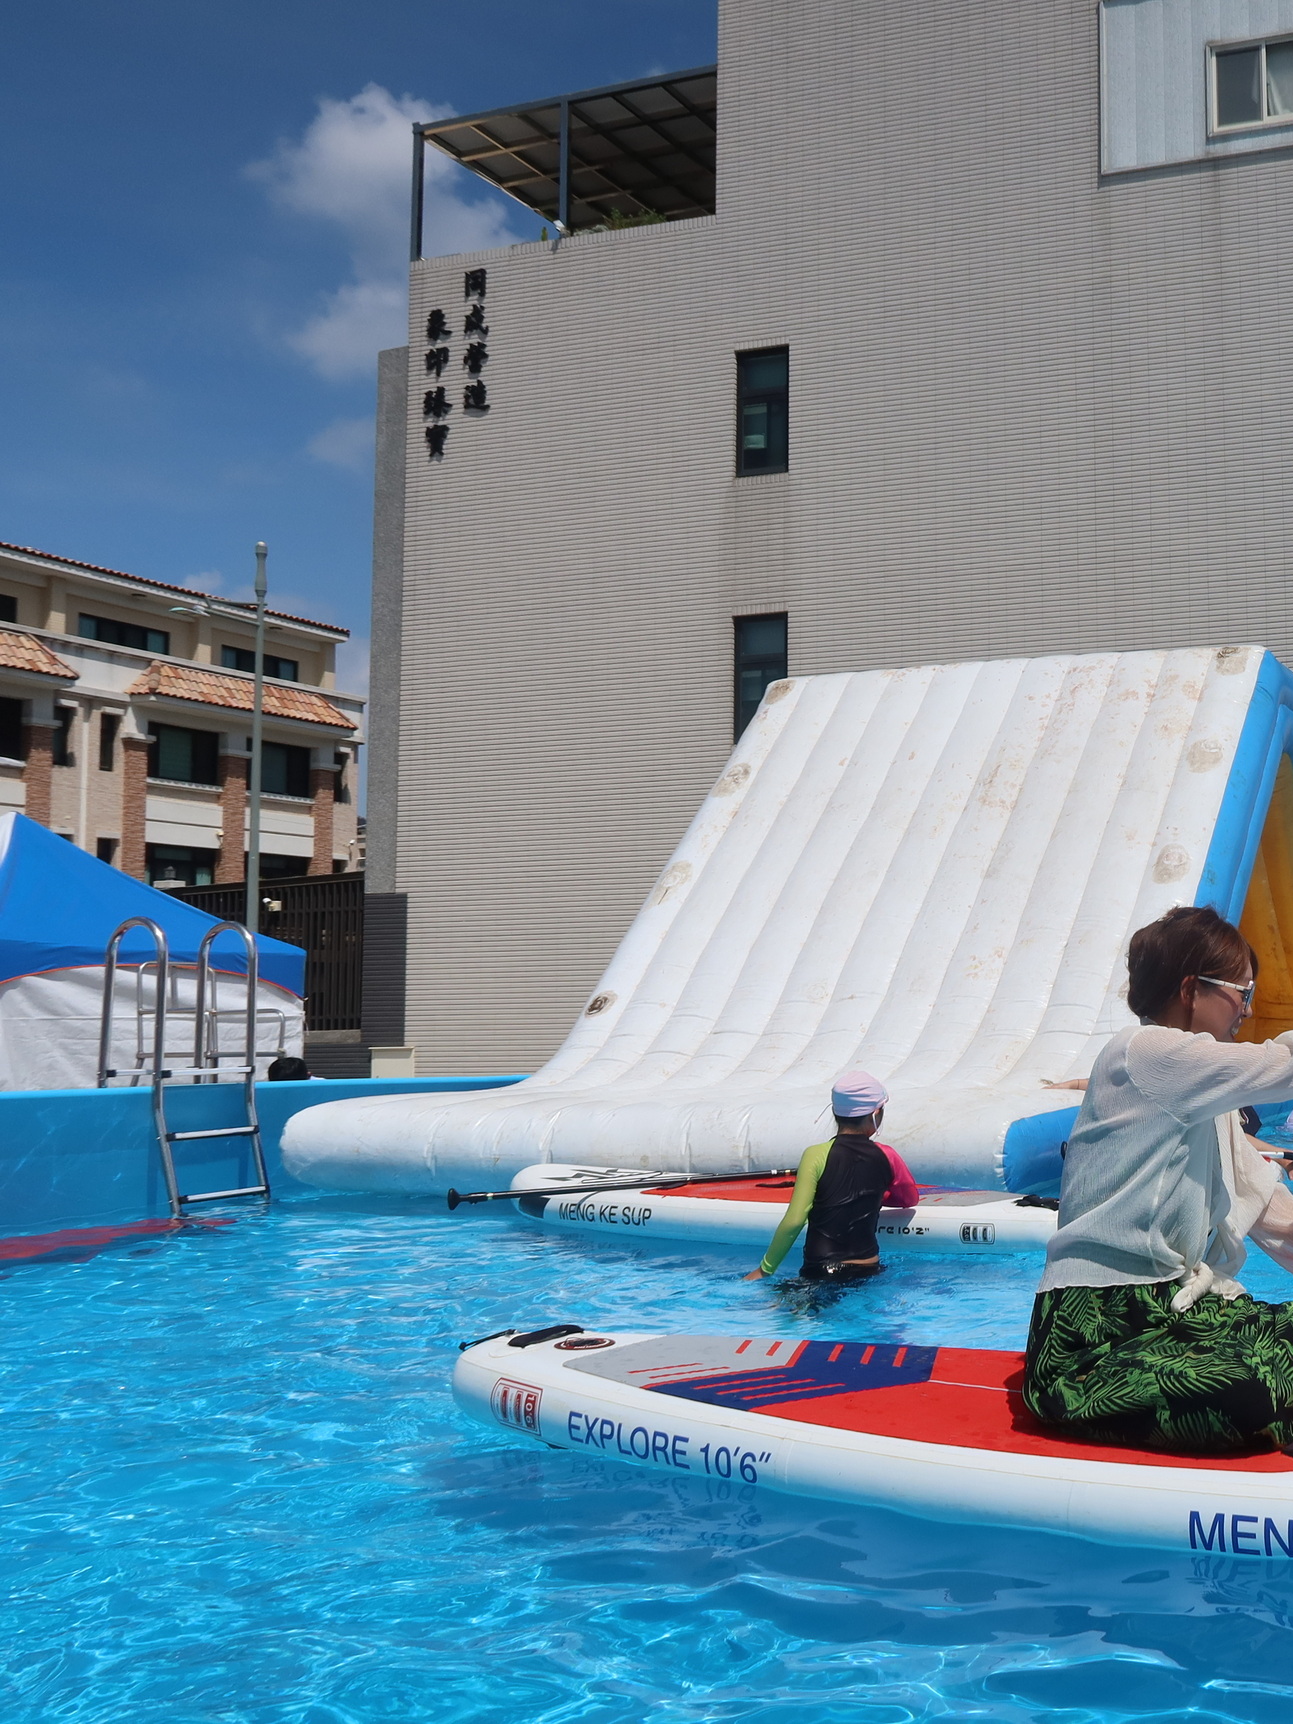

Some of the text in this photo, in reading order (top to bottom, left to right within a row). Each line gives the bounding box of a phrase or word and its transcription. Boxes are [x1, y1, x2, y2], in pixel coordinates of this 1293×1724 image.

[559, 1202, 652, 1226] MENG KE SUP
[567, 1410, 691, 1471] EXPLORE
